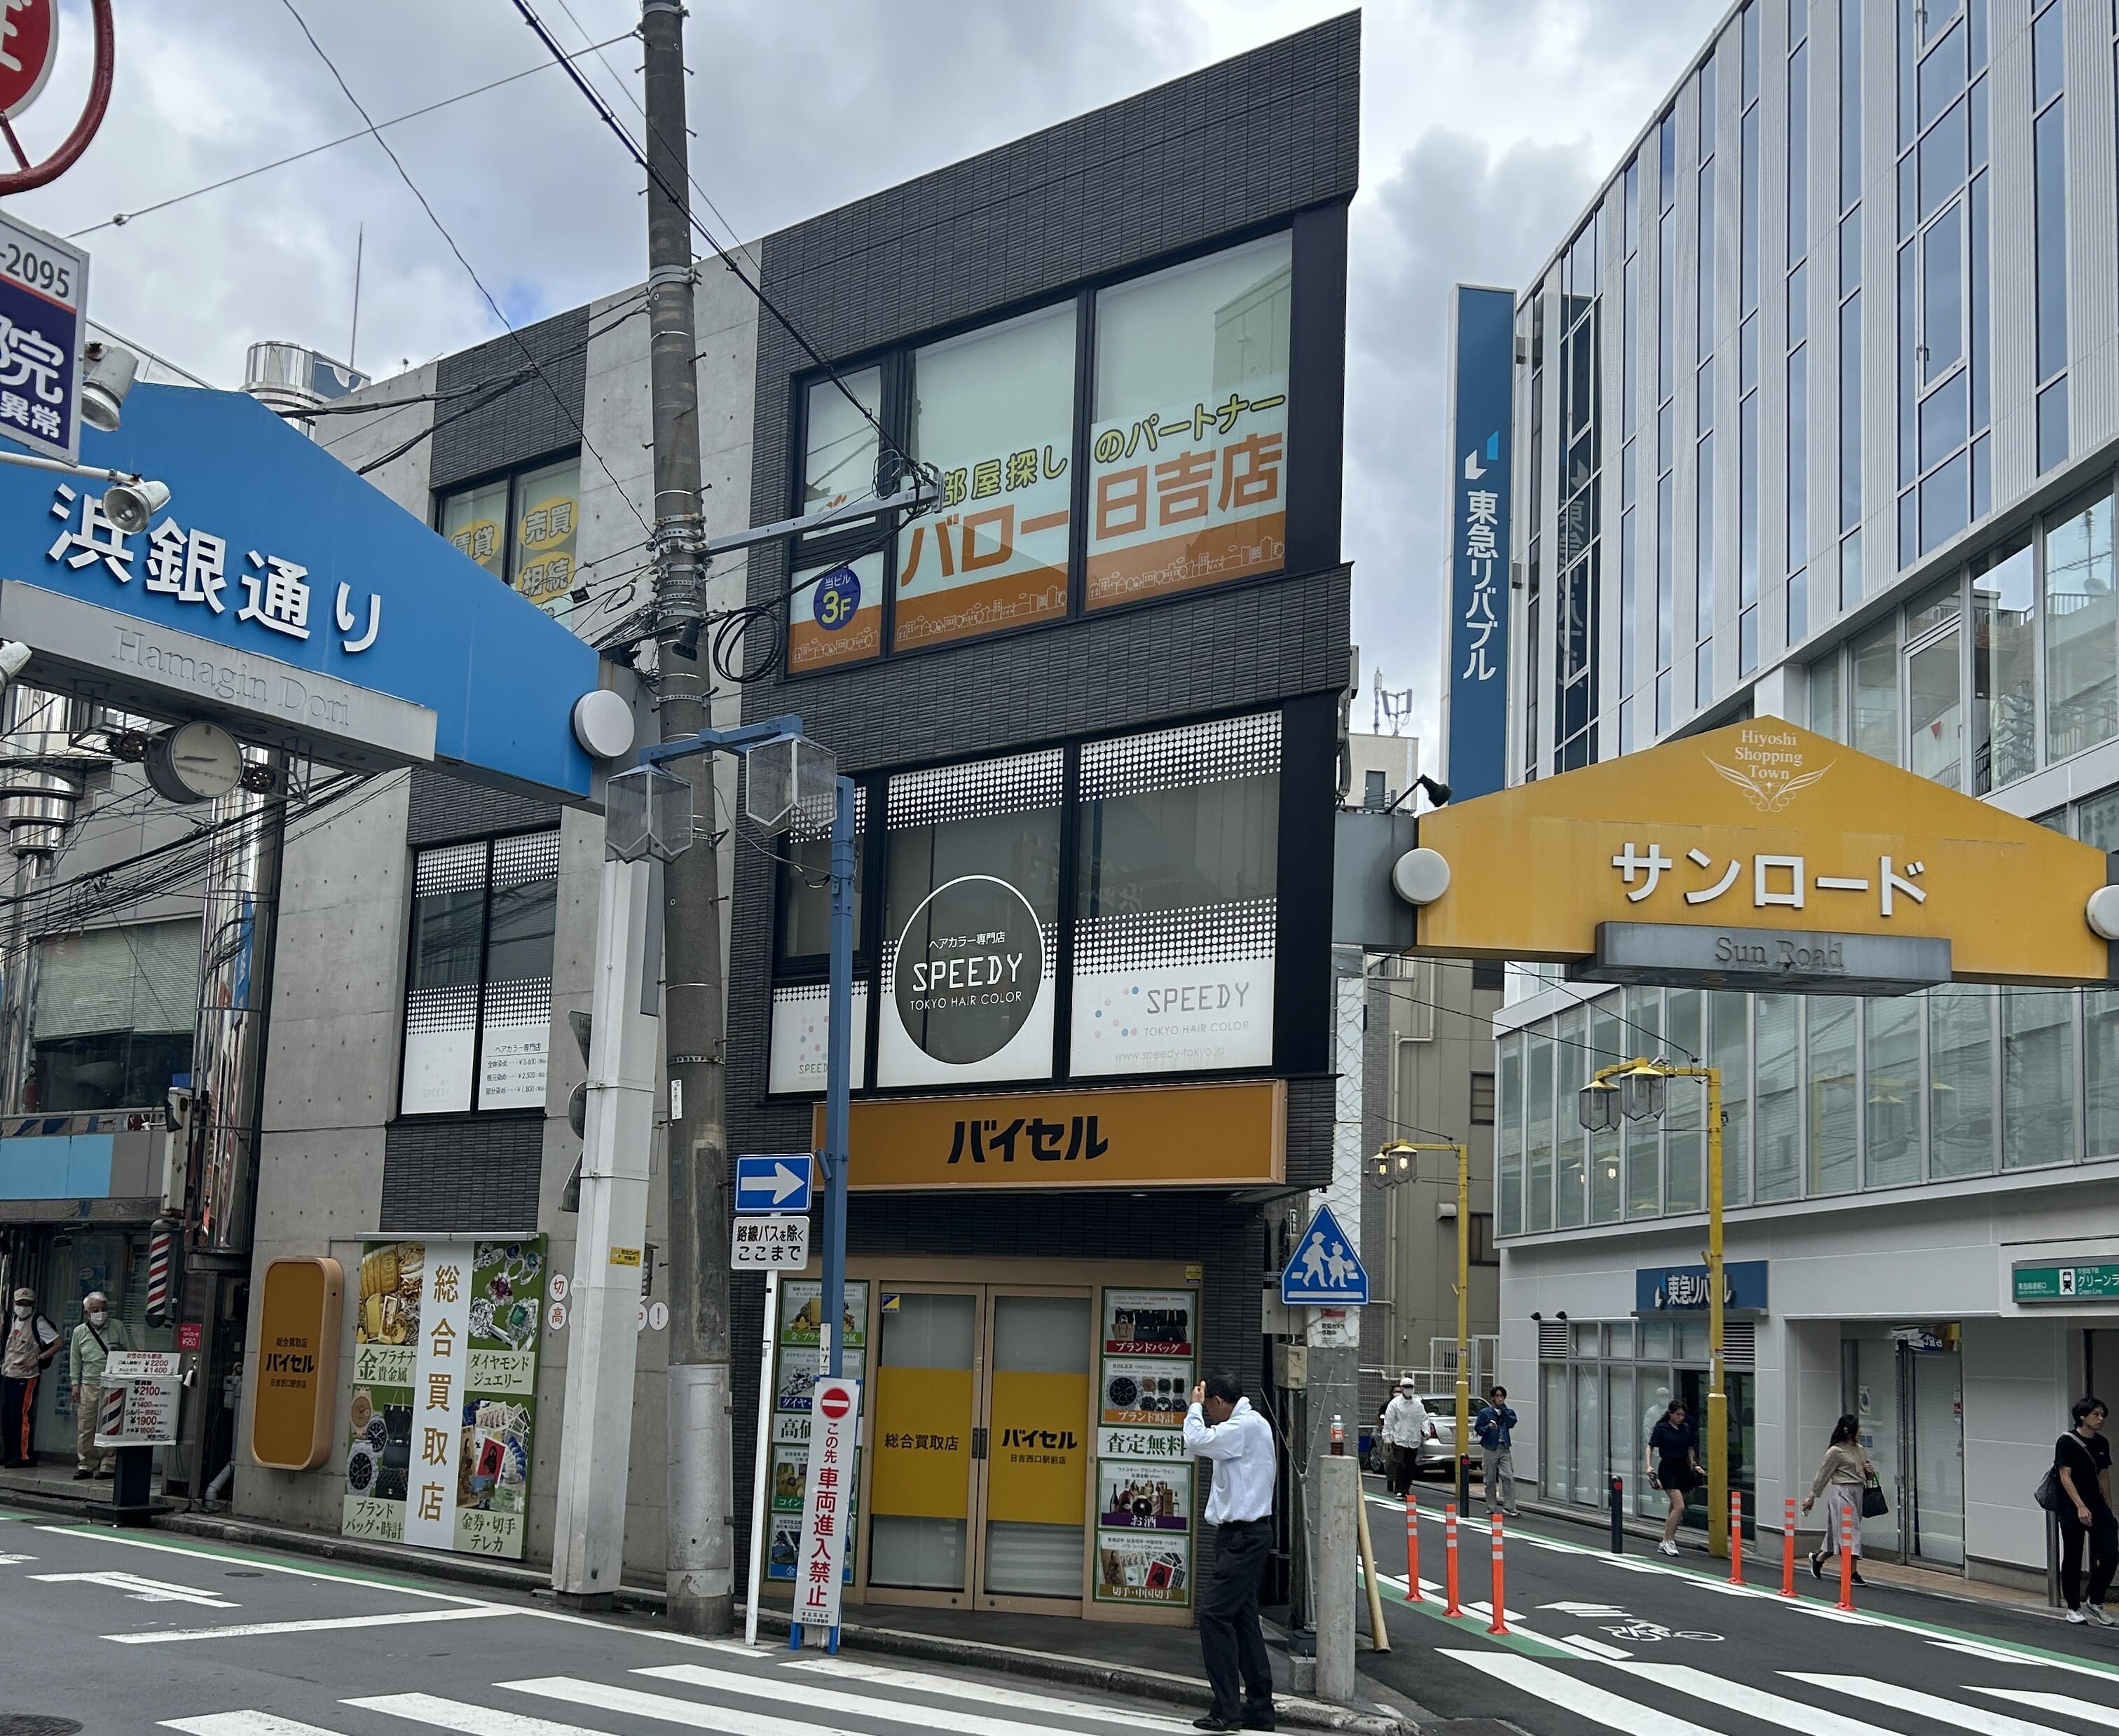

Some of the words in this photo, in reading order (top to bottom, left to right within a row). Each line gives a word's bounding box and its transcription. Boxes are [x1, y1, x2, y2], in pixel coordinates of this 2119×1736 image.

[908, 444, 1068, 514] 部屋探し
[1095, 393, 1286, 464] のパートナー
[900, 504, 1069, 587] バロー
[1095, 432, 1282, 542] 日吉店
[526, 502, 572, 544] 売買
[48, 482, 382, 652] 浜銀通り
[522, 557, 570, 598] 相続
[825, 574, 851, 589] 当ビル
[1462, 490, 1498, 681] 東急リバブル
[821, 590, 851, 624] 3F
[112, 626, 268, 702] Hamagin
[278, 674, 350, 726] Dori
[1741, 729, 1797, 747] Hiyoshi
[1734, 746, 1803, 766] Shopping
[1748, 764, 1789, 779] Town
[1612, 843, 1926, 916] サンロード
[928, 931, 1006, 950] ヘアカラー専門店
[1715, 937, 1767, 965] Sun
[1776, 939, 1843, 968] Road
[912, 952, 1023, 992] SPEEDY
[910, 994, 947, 1011] TOKYO
[950, 993, 976, 1007] HAIR
[980, 991, 1022, 1005] COLOR
[1146, 981, 1250, 1015] SPEEDY
[1143, 1024, 1179, 1037] TOKYO
[1182, 1022, 1207, 1035] HAIR
[1211, 1019, 1250, 1033] COLOR
[495, 1042, 542, 1053] ヘアカラー専門店
[1114, 1045, 1226, 1063] www.speedy-tokyo.jp
[947, 1115, 1109, 1164] バイセル
[736, 1225, 804, 1242] 路線バスを除く
[739, 1245, 802, 1262] ここまで
[1667, 1272, 1732, 1304] 東急リバル
[551, 1307, 563, 1324] 高
[1116, 1342, 1181, 1354] ブランドバッグ
[265, 1353, 315, 1373] バイセル
[357, 1348, 378, 1381] 金
[379, 1349, 416, 1366] プラチナ
[470, 1353, 529, 1372] ダイヤモンド
[378, 1366, 408, 1383] 貴金属
[474, 1372, 523, 1389] ジュエリー
[134, 1386, 160, 1396] ¥2100
[418, 1265, 460, 1522] 総合買取店
[130, 1416, 157, 1425] ¥1900
[1118, 1412, 1176, 1424] ブランド時計
[823, 1422, 839, 1463] この先
[884, 1433, 959, 1451] 総合買取店
[1002, 1428, 1078, 1449] バイセル
[1106, 1432, 1187, 1456] 査定無料
[1010, 1454, 1066, 1465] 日吉西口駅前店
[355, 1501, 394, 1519] ブランド
[345, 1520, 404, 1540] バッグ・時計
[461, 1512, 516, 1536] 金券・切手
[1130, 1515, 1156, 1528] お酒
[470, 1534, 504, 1553] テレカ
[805, 1466, 839, 1607] 車両進入禁止
